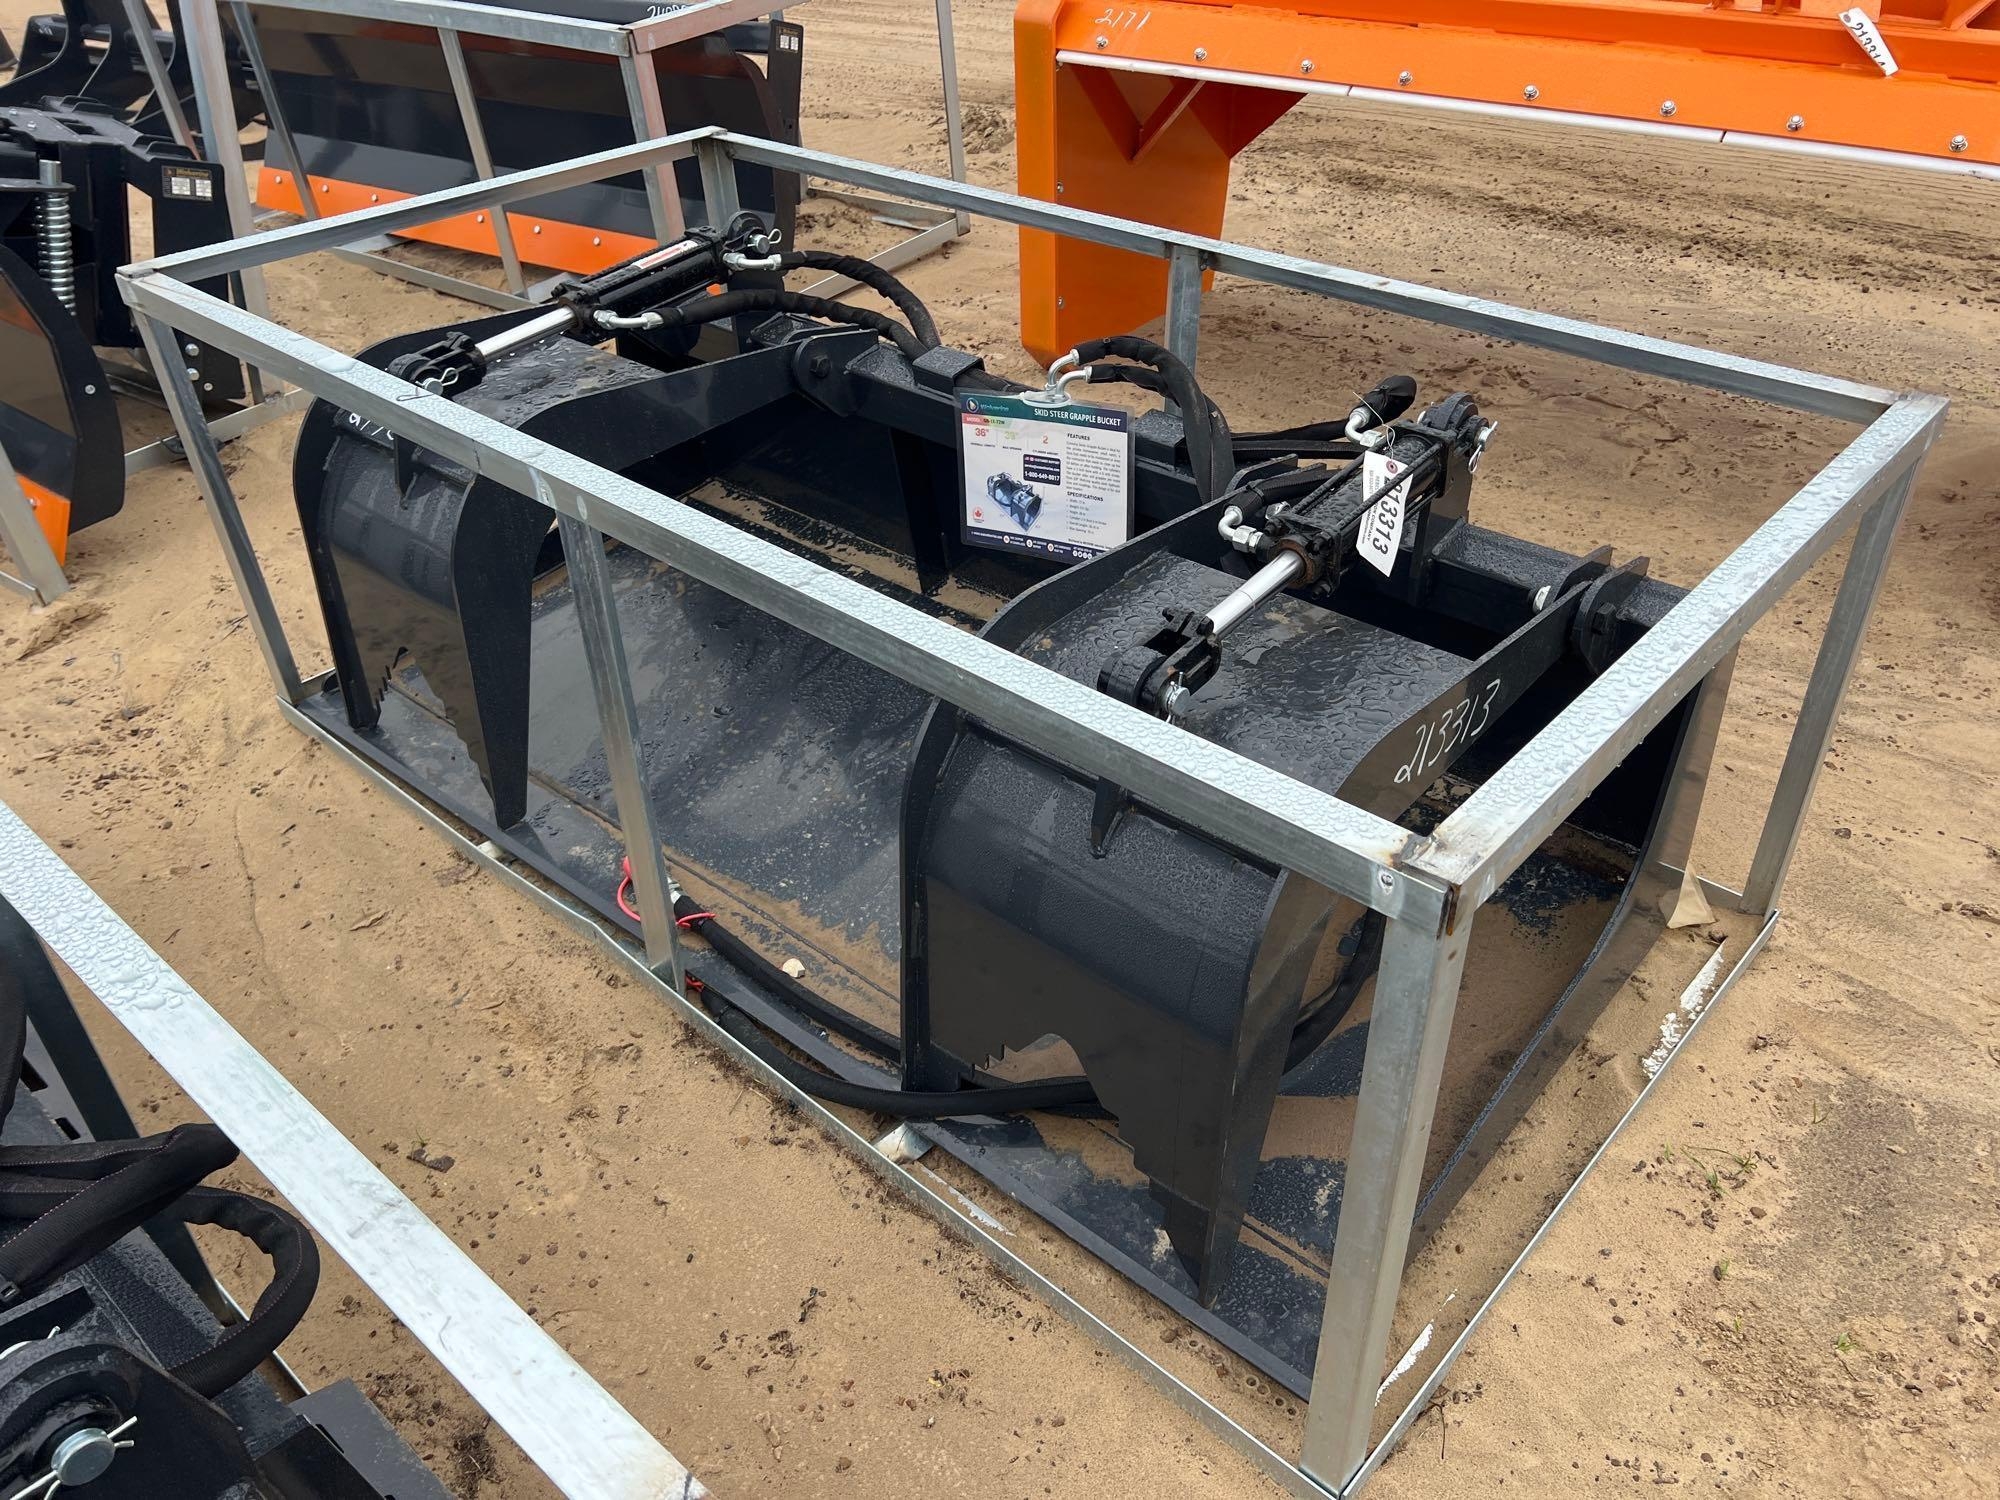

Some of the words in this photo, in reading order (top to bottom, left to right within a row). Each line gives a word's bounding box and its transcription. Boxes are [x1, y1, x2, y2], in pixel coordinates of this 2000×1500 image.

[1034, 408, 1049, 417] SKID
[1050, 410, 1069, 419] STEER
[1069, 412, 1096, 423] GRAPPLE
[1097, 416, 1121, 426] BUCKET
[1042, 436, 1049, 444] 2
[1067, 433, 1090, 441] FEATURES
[1067, 491, 1104, 502] SPECIFICATIONS
[1393, 678, 1501, 784] 213313
